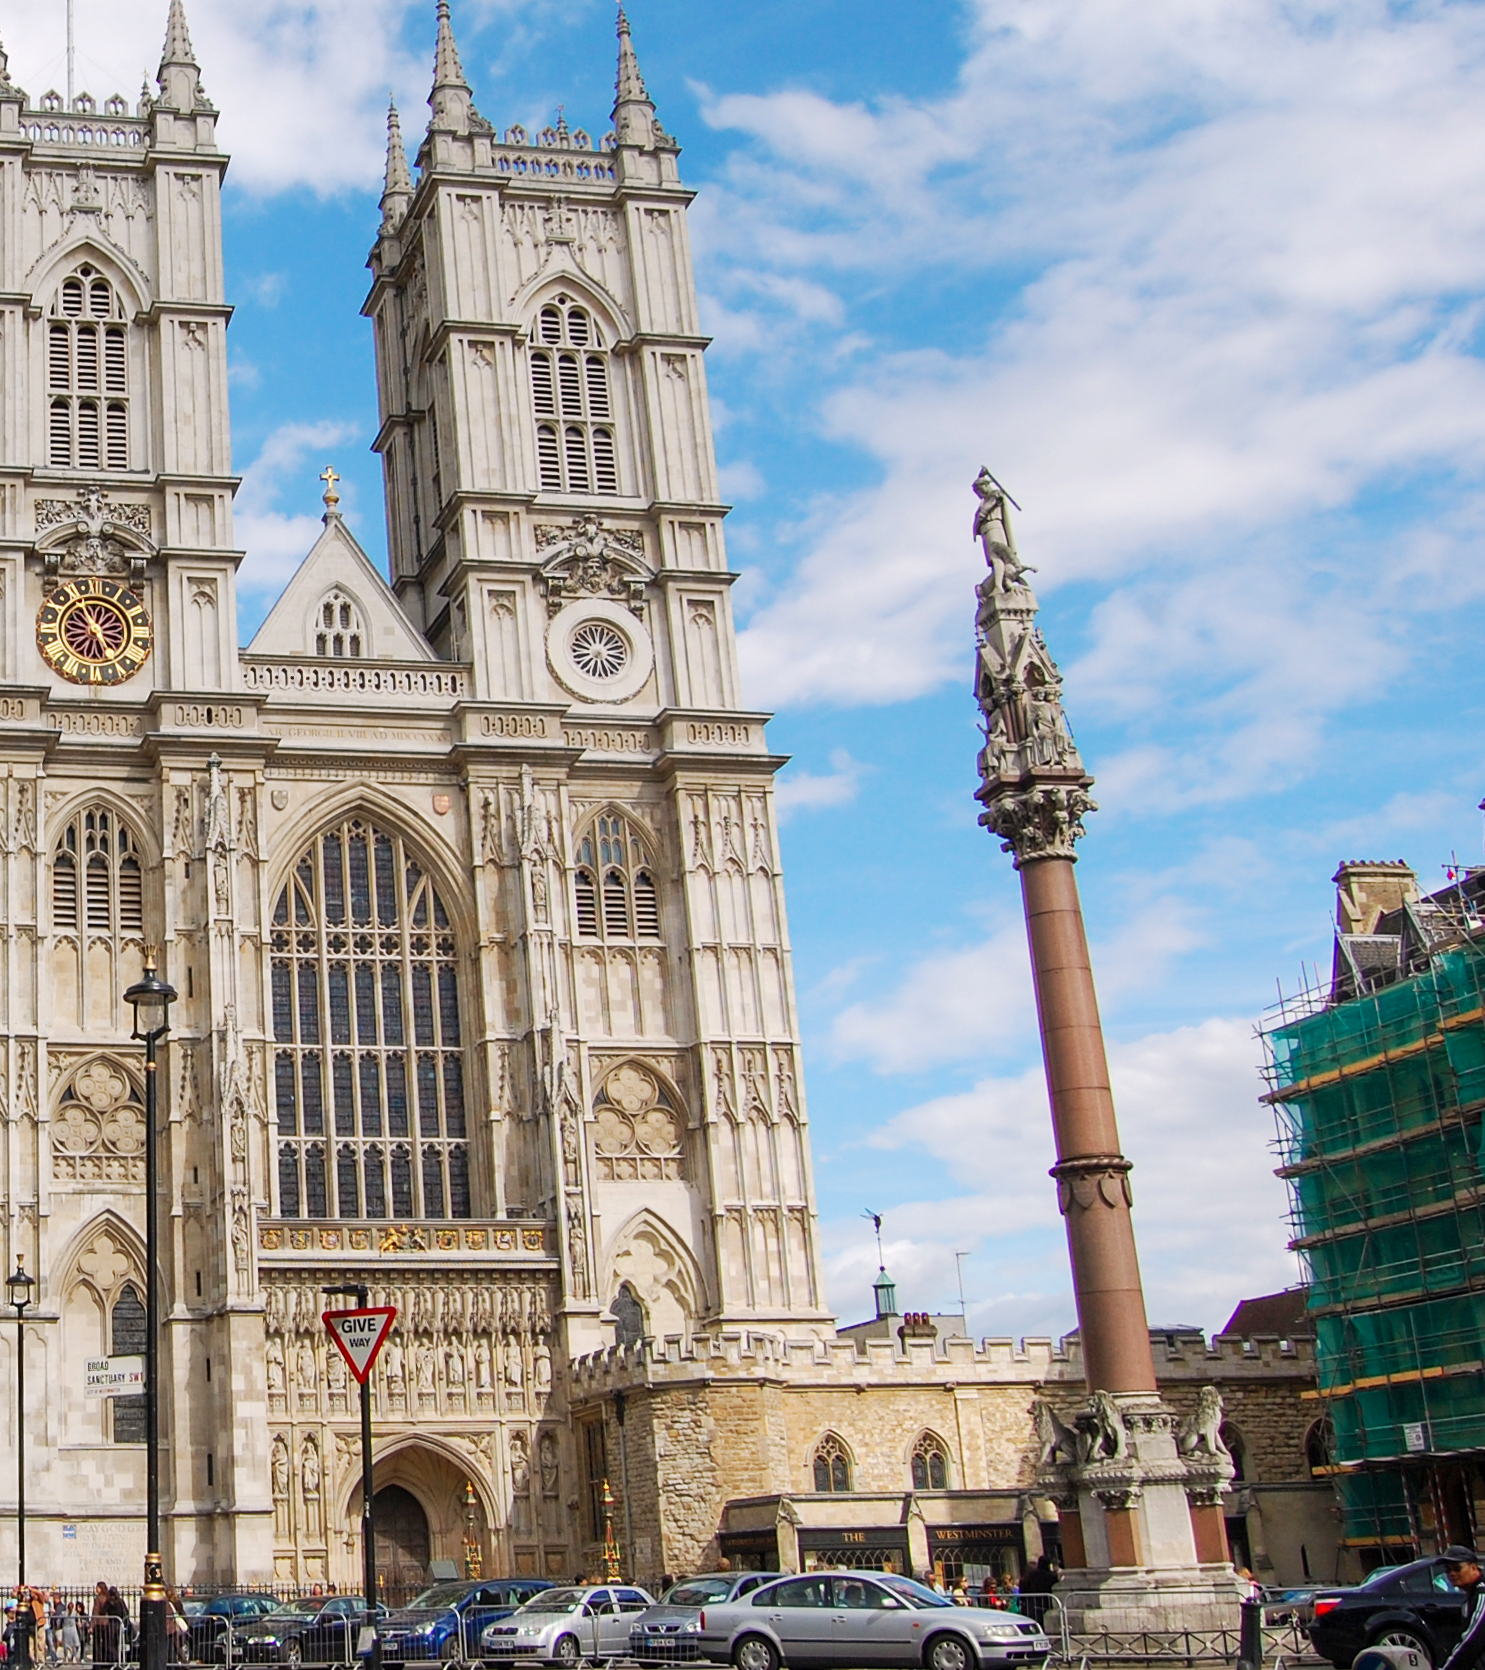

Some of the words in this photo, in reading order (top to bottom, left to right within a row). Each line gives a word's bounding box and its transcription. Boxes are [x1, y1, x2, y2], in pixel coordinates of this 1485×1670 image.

[341, 1318, 376, 1333] GIVE
[349, 1337, 371, 1348] WAY
[87, 1361, 109, 1371] BROAD
[87, 1373, 125, 1385] SANCTUARY
[79, 1524, 100, 1533] MAY
[102, 1524, 126, 1533] GOD
[841, 1532, 865, 1542] THE
[935, 1528, 1013, 1540] WESTMINSTER
